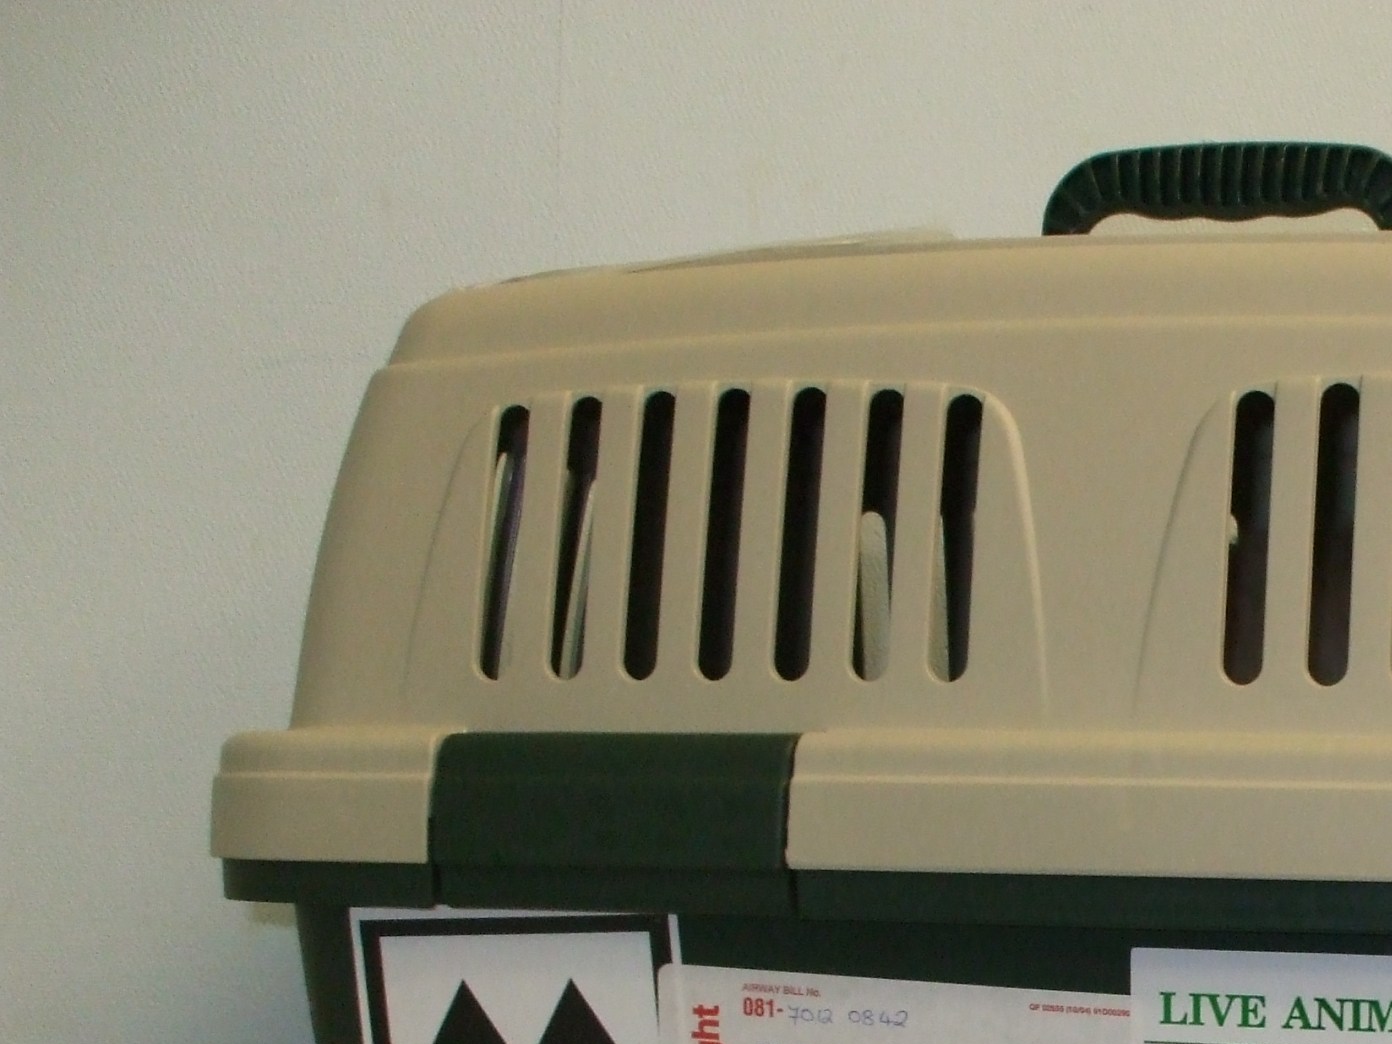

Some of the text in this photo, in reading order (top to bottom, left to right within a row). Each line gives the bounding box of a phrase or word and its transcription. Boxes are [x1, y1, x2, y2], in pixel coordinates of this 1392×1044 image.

[742, 984, 782, 994] AIRWAY
[783, 986, 804, 996] BILL
[1159, 991, 1267, 1028] LIVE
[848, 1010, 908, 1027] 0842
